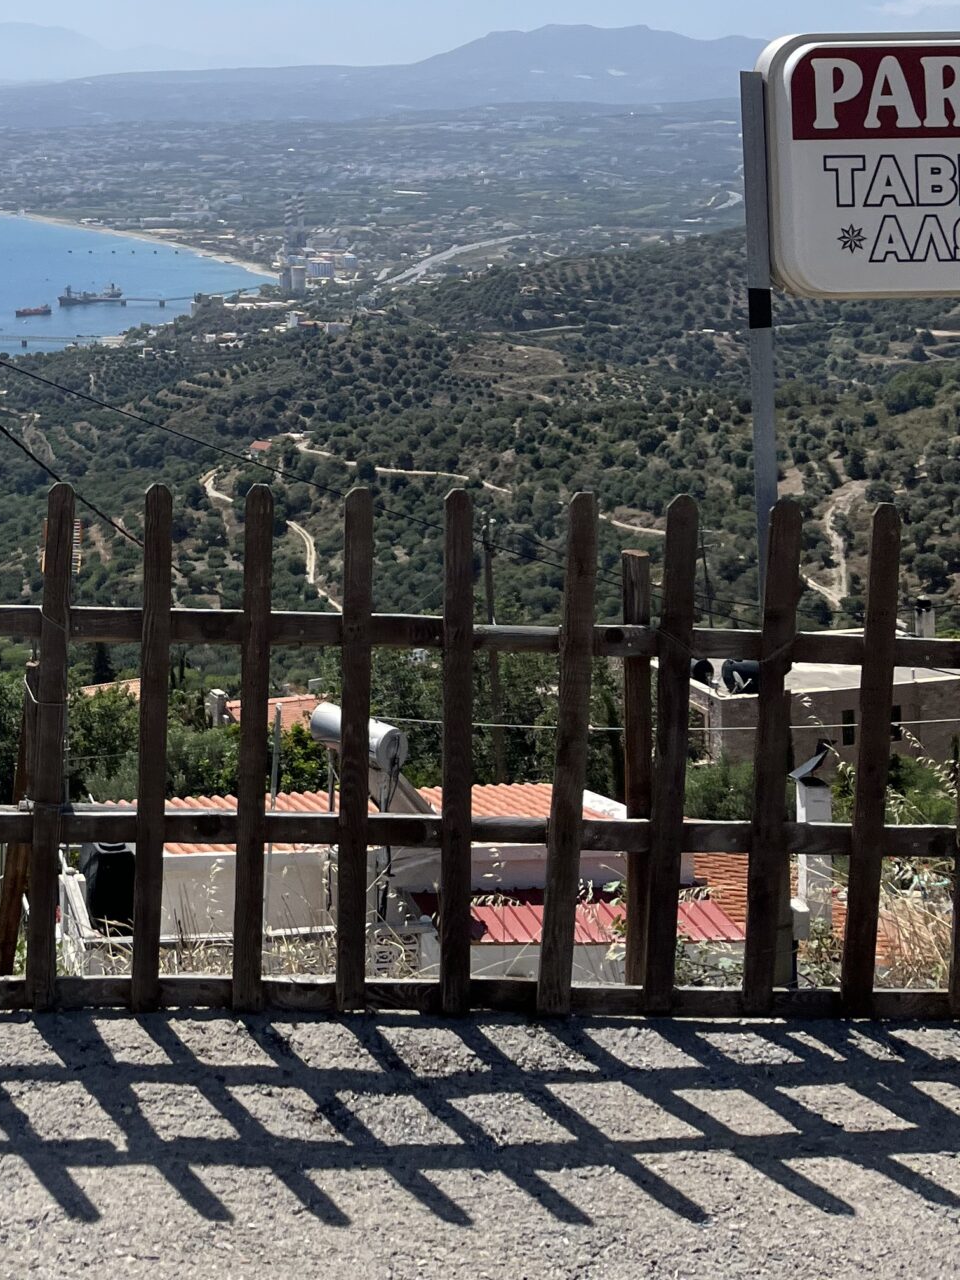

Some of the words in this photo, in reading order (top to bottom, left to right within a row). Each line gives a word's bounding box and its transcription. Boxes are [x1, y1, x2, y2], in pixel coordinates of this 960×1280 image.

[810, 55, 960, 130] PAR
[823, 154, 960, 208] ΤΑΒ
[868, 214, 960, 262] ΑΛ
